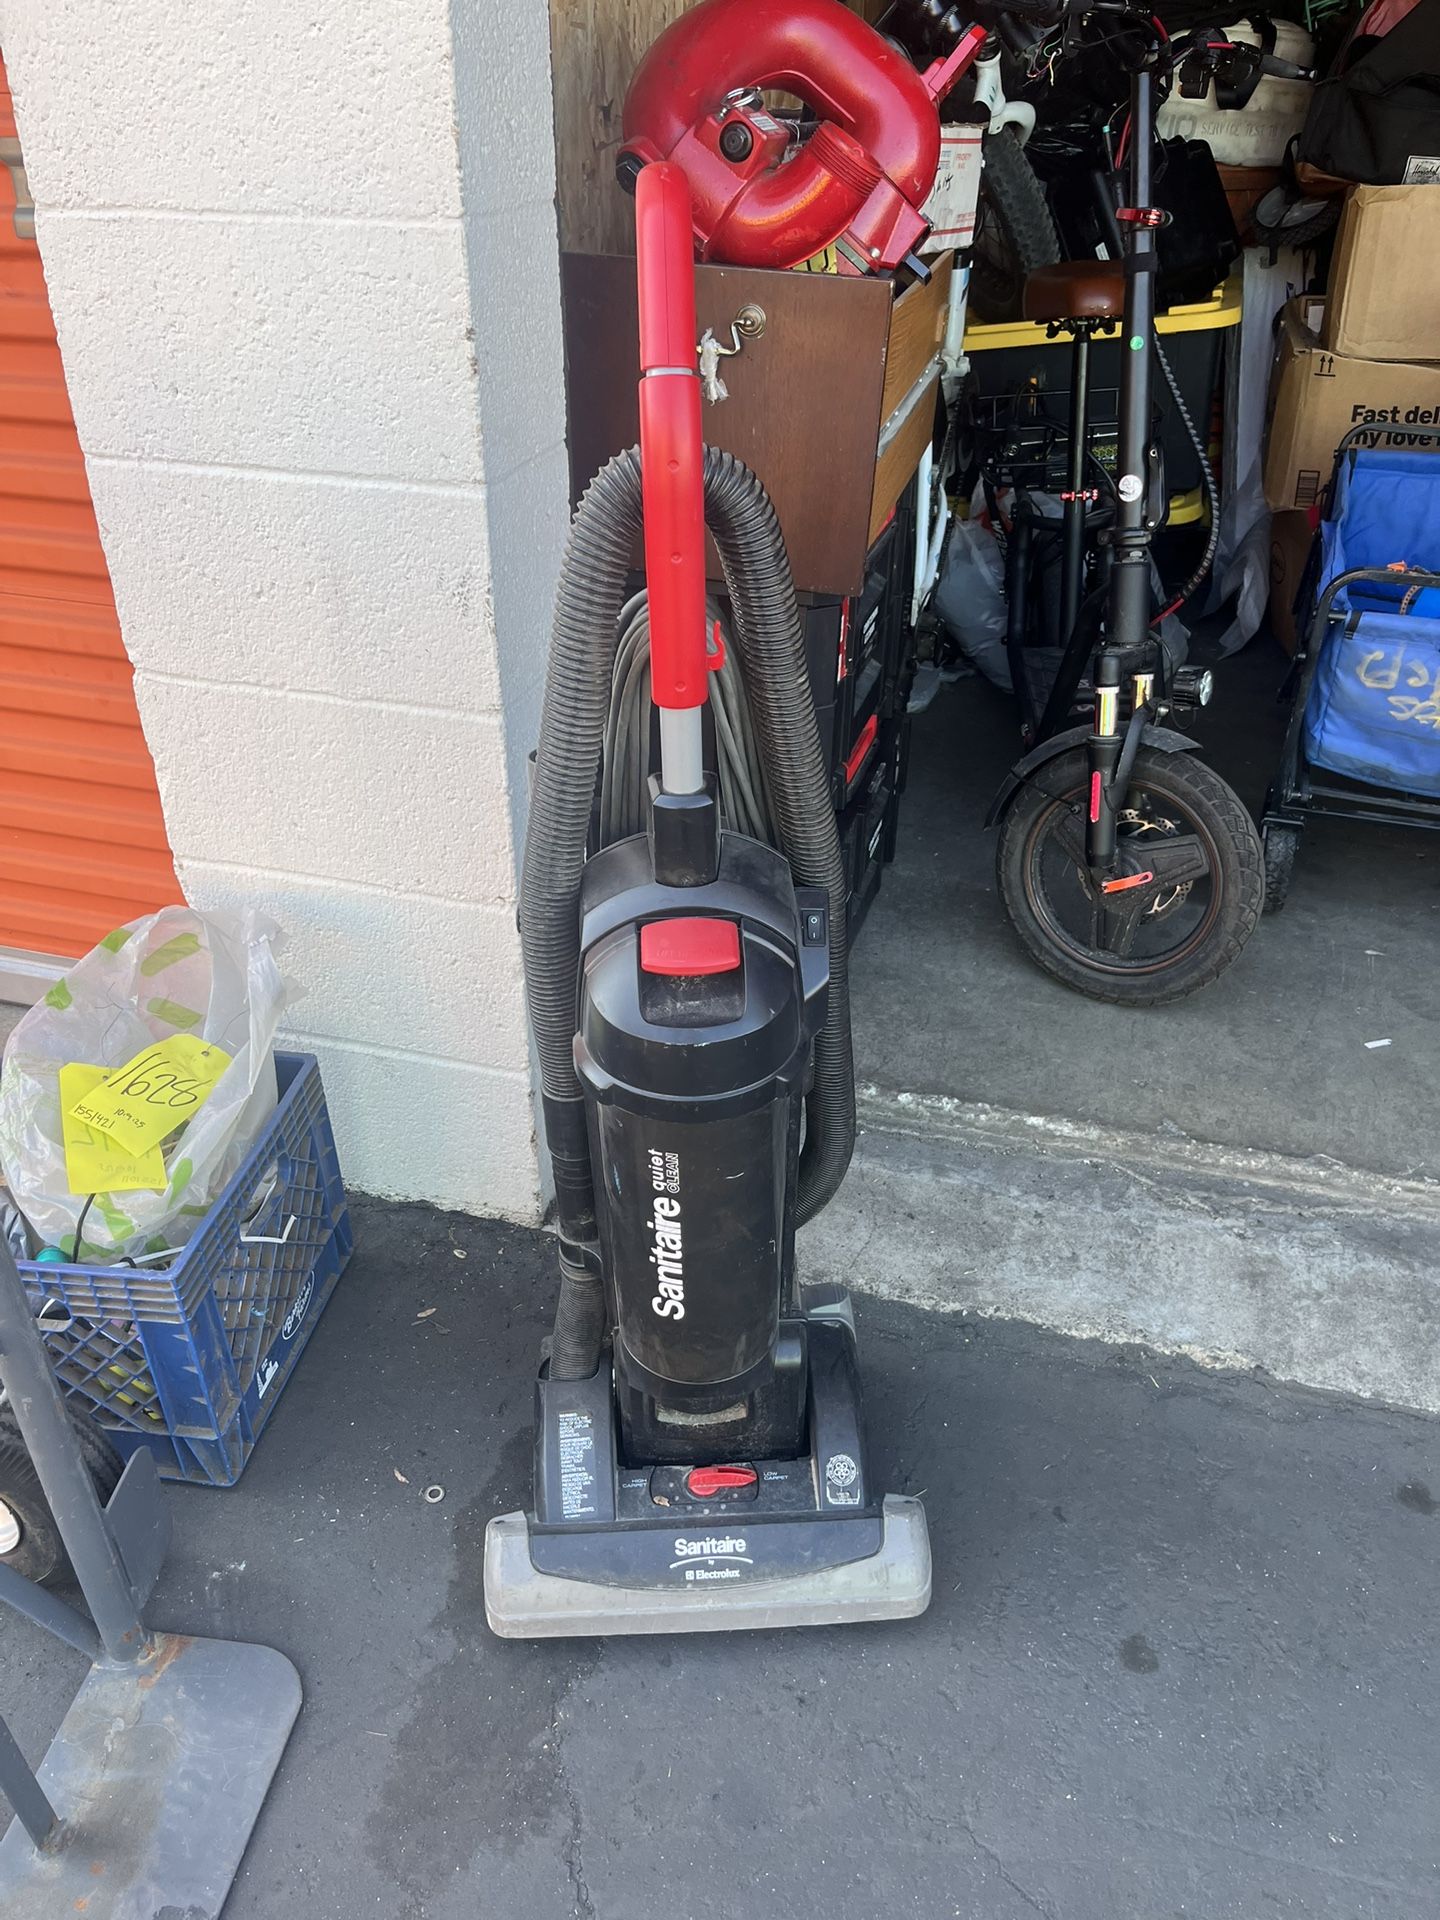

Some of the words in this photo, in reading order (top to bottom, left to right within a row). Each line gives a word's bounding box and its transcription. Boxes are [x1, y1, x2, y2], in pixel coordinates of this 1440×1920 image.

[1350, 404, 1401, 425] Fast
[1386, 431, 1432, 447] love
[107, 1052, 213, 1107] 1628
[647, 1148, 668, 1192] quiet
[665, 1152, 681, 1194] CLEAN
[646, 1196, 686, 1321] Sanitaire
[674, 1535, 747, 1557] Sanitaire
[695, 1567, 741, 1580] Electrolux
